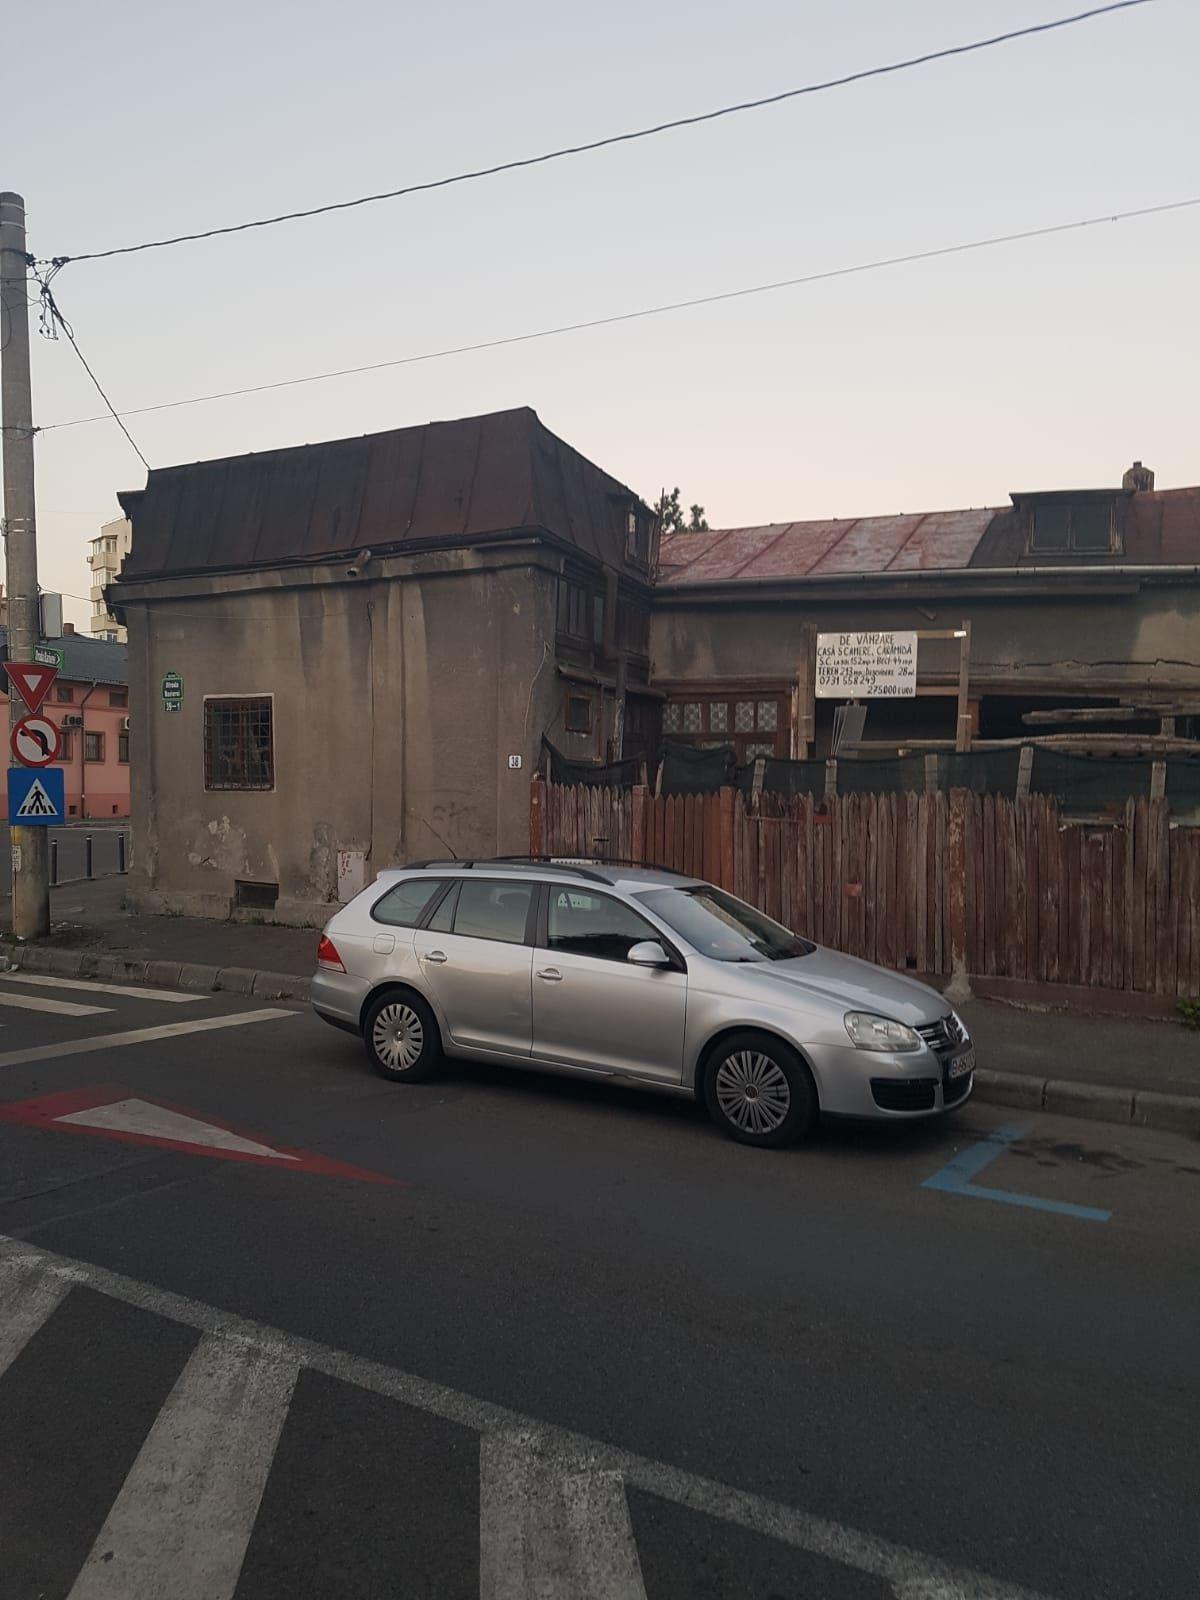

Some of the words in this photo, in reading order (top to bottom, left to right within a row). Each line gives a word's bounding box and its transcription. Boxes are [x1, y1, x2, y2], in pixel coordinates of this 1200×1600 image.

[840, 635, 851, 645] DE
[818, 667, 838, 676] TEREN
[820, 676, 839, 685] 0731
